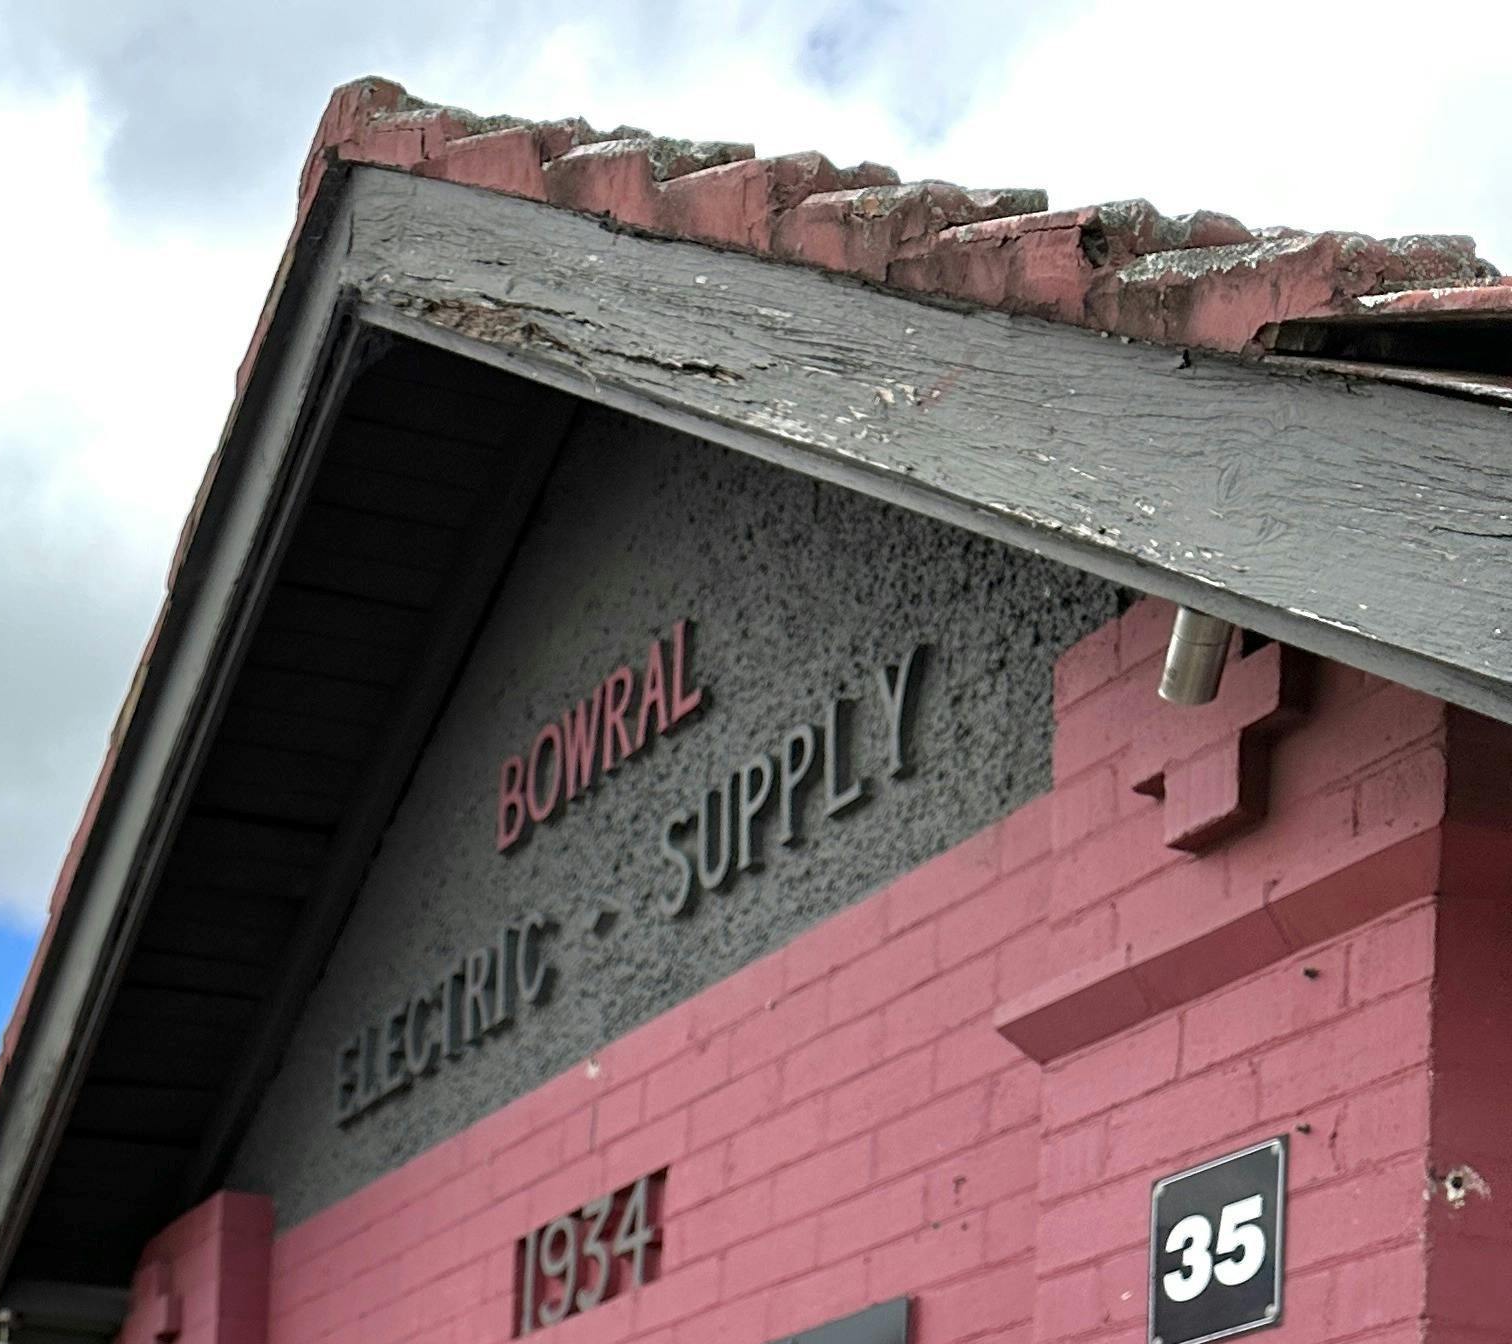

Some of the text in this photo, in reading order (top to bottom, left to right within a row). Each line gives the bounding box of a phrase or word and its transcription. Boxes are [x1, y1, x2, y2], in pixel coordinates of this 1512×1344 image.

[497, 618, 702, 853] BOWRAL
[335, 643, 929, 1122] ELECTRIC SUPPLY
[516, 1172, 660, 1336] 1934
[1162, 1194, 1267, 1302] 35
